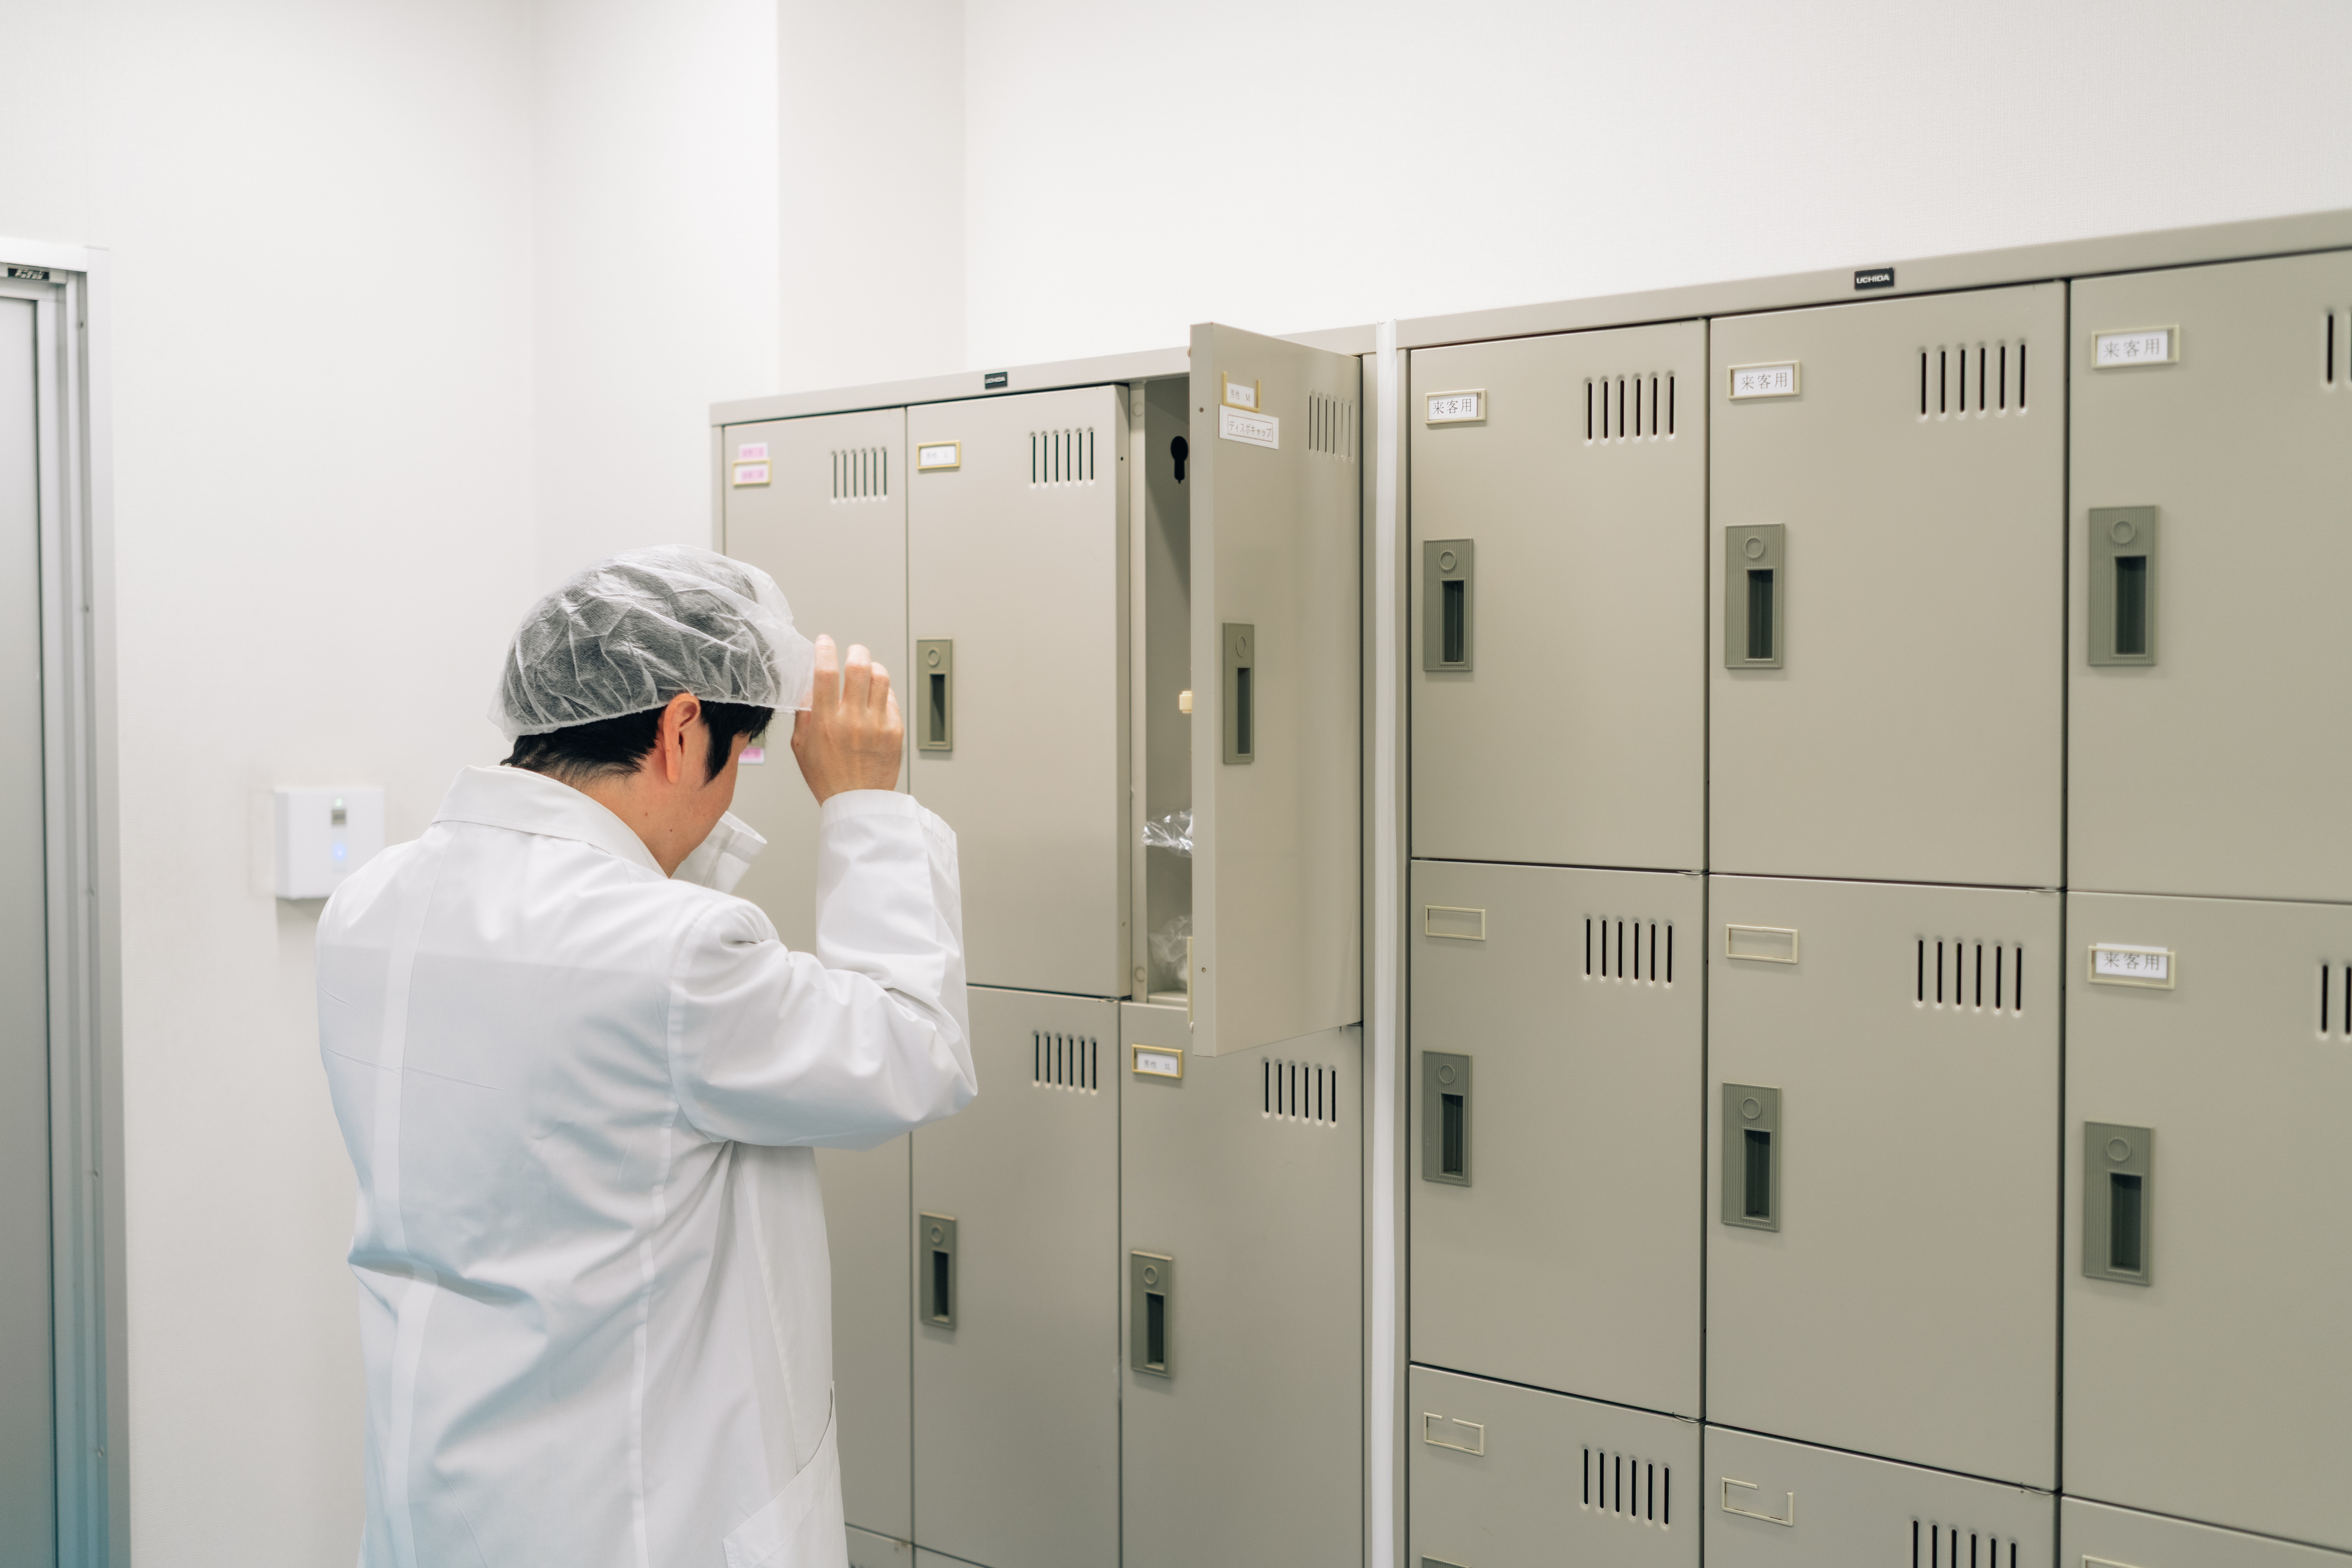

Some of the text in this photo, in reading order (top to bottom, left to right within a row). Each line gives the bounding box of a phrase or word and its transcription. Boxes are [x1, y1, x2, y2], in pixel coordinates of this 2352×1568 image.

[1856, 274, 1890, 284] UCHIDA
[2102, 338, 2160, 359] 来客用
[1740, 372, 1787, 390] 来客用
[1230, 388, 1251, 402] 男性 M
[1432, 398, 1472, 415] 来客用
[1229, 420, 1272, 438] ディスポキャップ
[2102, 951, 2159, 971] 来客用
